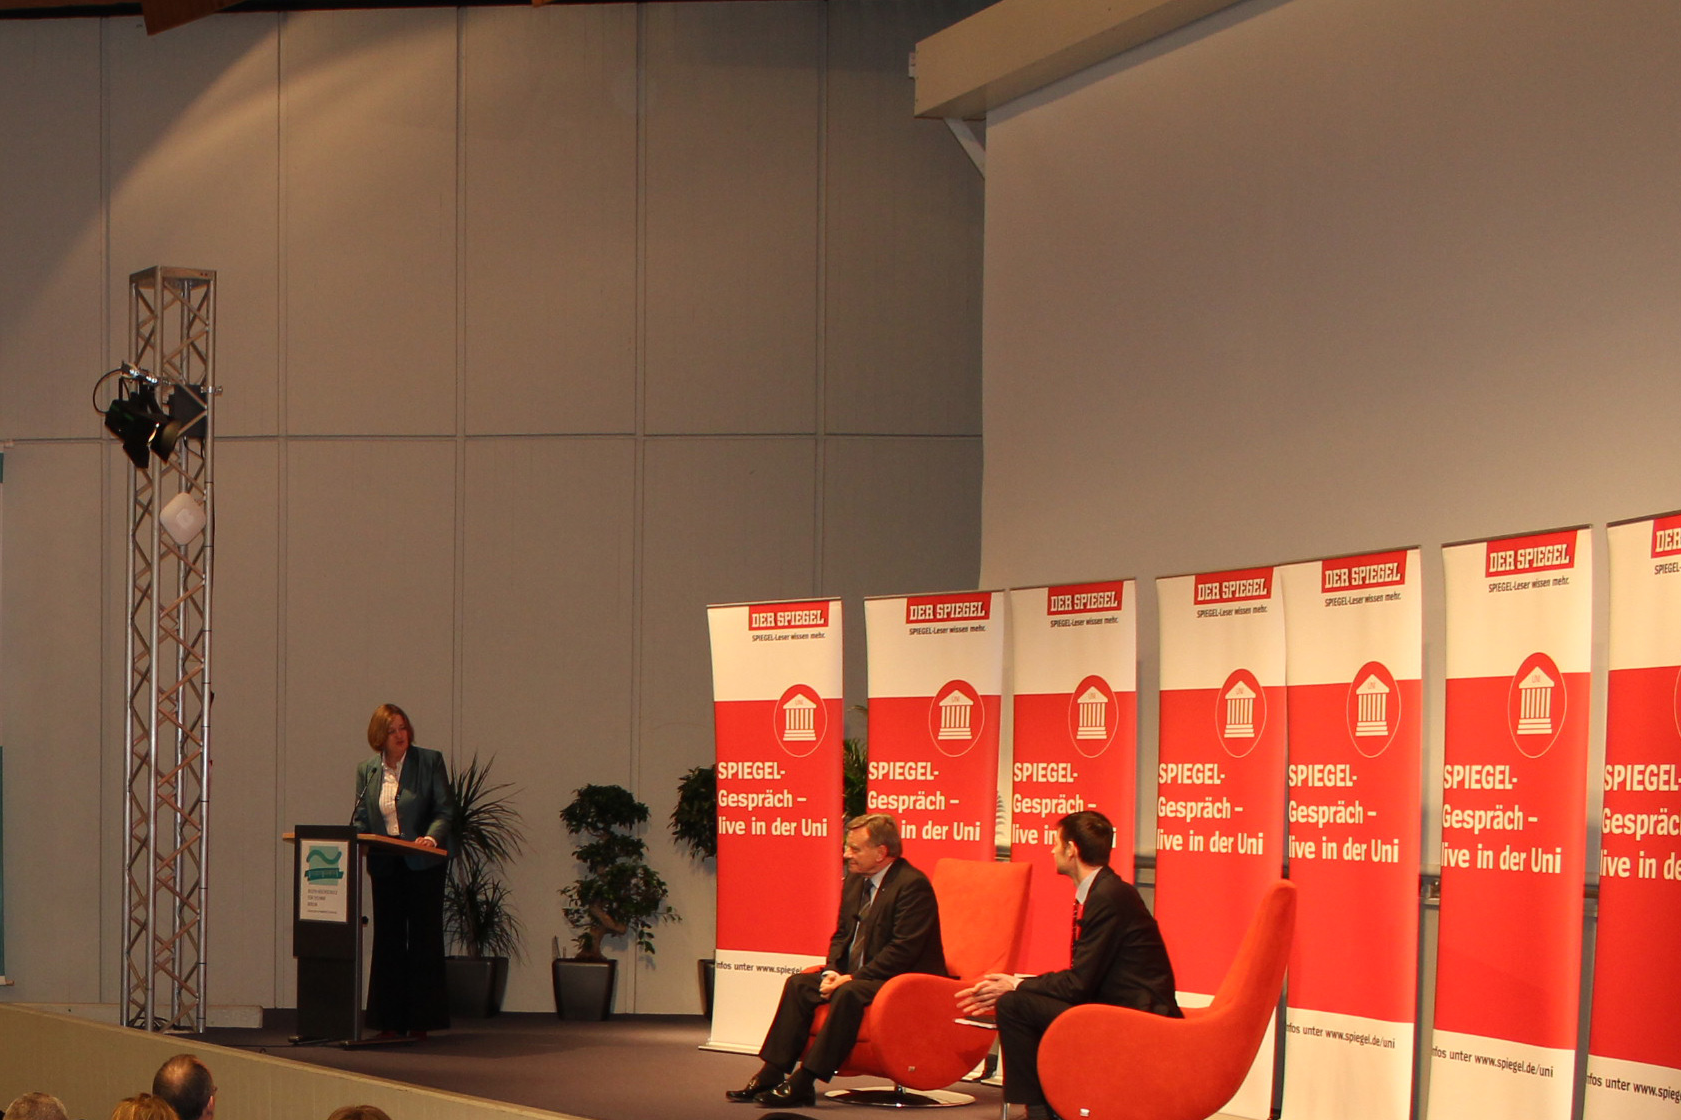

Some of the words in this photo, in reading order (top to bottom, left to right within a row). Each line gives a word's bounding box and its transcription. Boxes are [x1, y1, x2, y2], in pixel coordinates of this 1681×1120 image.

[1489, 552, 1515, 573] DER
[1517, 544, 1569, 570] SPIEGEL
[1325, 569, 1349, 588] DER
[1351, 563, 1401, 585] SPIEGEL
[1531, 578, 1550, 588] wissen
[1197, 582, 1220, 601] DER
[1223, 578, 1267, 599] SPIEGEL
[1365, 594, 1384, 604] wissen
[910, 604, 933, 620] DER
[936, 601, 985, 619] SPIEGEL
[1050, 595, 1072, 612] DER
[1074, 591, 1118, 610] SPIEGEL
[1235, 607, 1251, 615] wissen
[752, 612, 775, 627] DER
[777, 610, 825, 626] SPIEGEL
[1086, 617, 1103, 625] wissen
[950, 626, 968, 634] wissen
[718, 761, 786, 780] SPIEGEL-
[868, 761, 939, 780] SPIEGEL-
[1013, 762, 1078, 782] SPIEGEL-
[1159, 763, 1225, 785] SPIEGEL-
[1288, 764, 1357, 787] SPIEGEL-
[1443, 765, 1518, 790] SPIEGEL-
[718, 789, 793, 811] Gespräch
[868, 791, 945, 813] Gespräch
[1012, 794, 1084, 818] Gespräch
[1158, 797, 1231, 823] Gespräch
[1288, 800, 1364, 828] Gespräch
[1442, 804, 1523, 835] Gespräch
[1601, 807, 1681, 841] Gespräc
[718, 816, 746, 835] live
[751, 817, 766, 835] in
[771, 817, 797, 836] der
[801, 818, 828, 837] Uni
[901, 820, 916, 839] in
[922, 820, 949, 840] der
[953, 822, 981, 841] Uni
[1189, 830, 1203, 852] in
[1209, 831, 1234, 854] der
[1238, 832, 1264, 855] Uni
[1322, 836, 1337, 860] in
[1342, 837, 1367, 861] der
[1371, 839, 1399, 863] Uni
[1477, 843, 1493, 869] in
[1499, 845, 1526, 871] der
[1530, 847, 1561, 874] Uni
[1638, 850, 1657, 879] in
[734, 963, 754, 971] unter
[1303, 1026, 1323, 1037] unter
[1325, 1029, 1396, 1049] www.spiegel.de/uni
[1449, 1051, 1472, 1062] unter
[1474, 1056, 1554, 1078] www.spiegel.de/uni
[1605, 1078, 1630, 1091] unter
